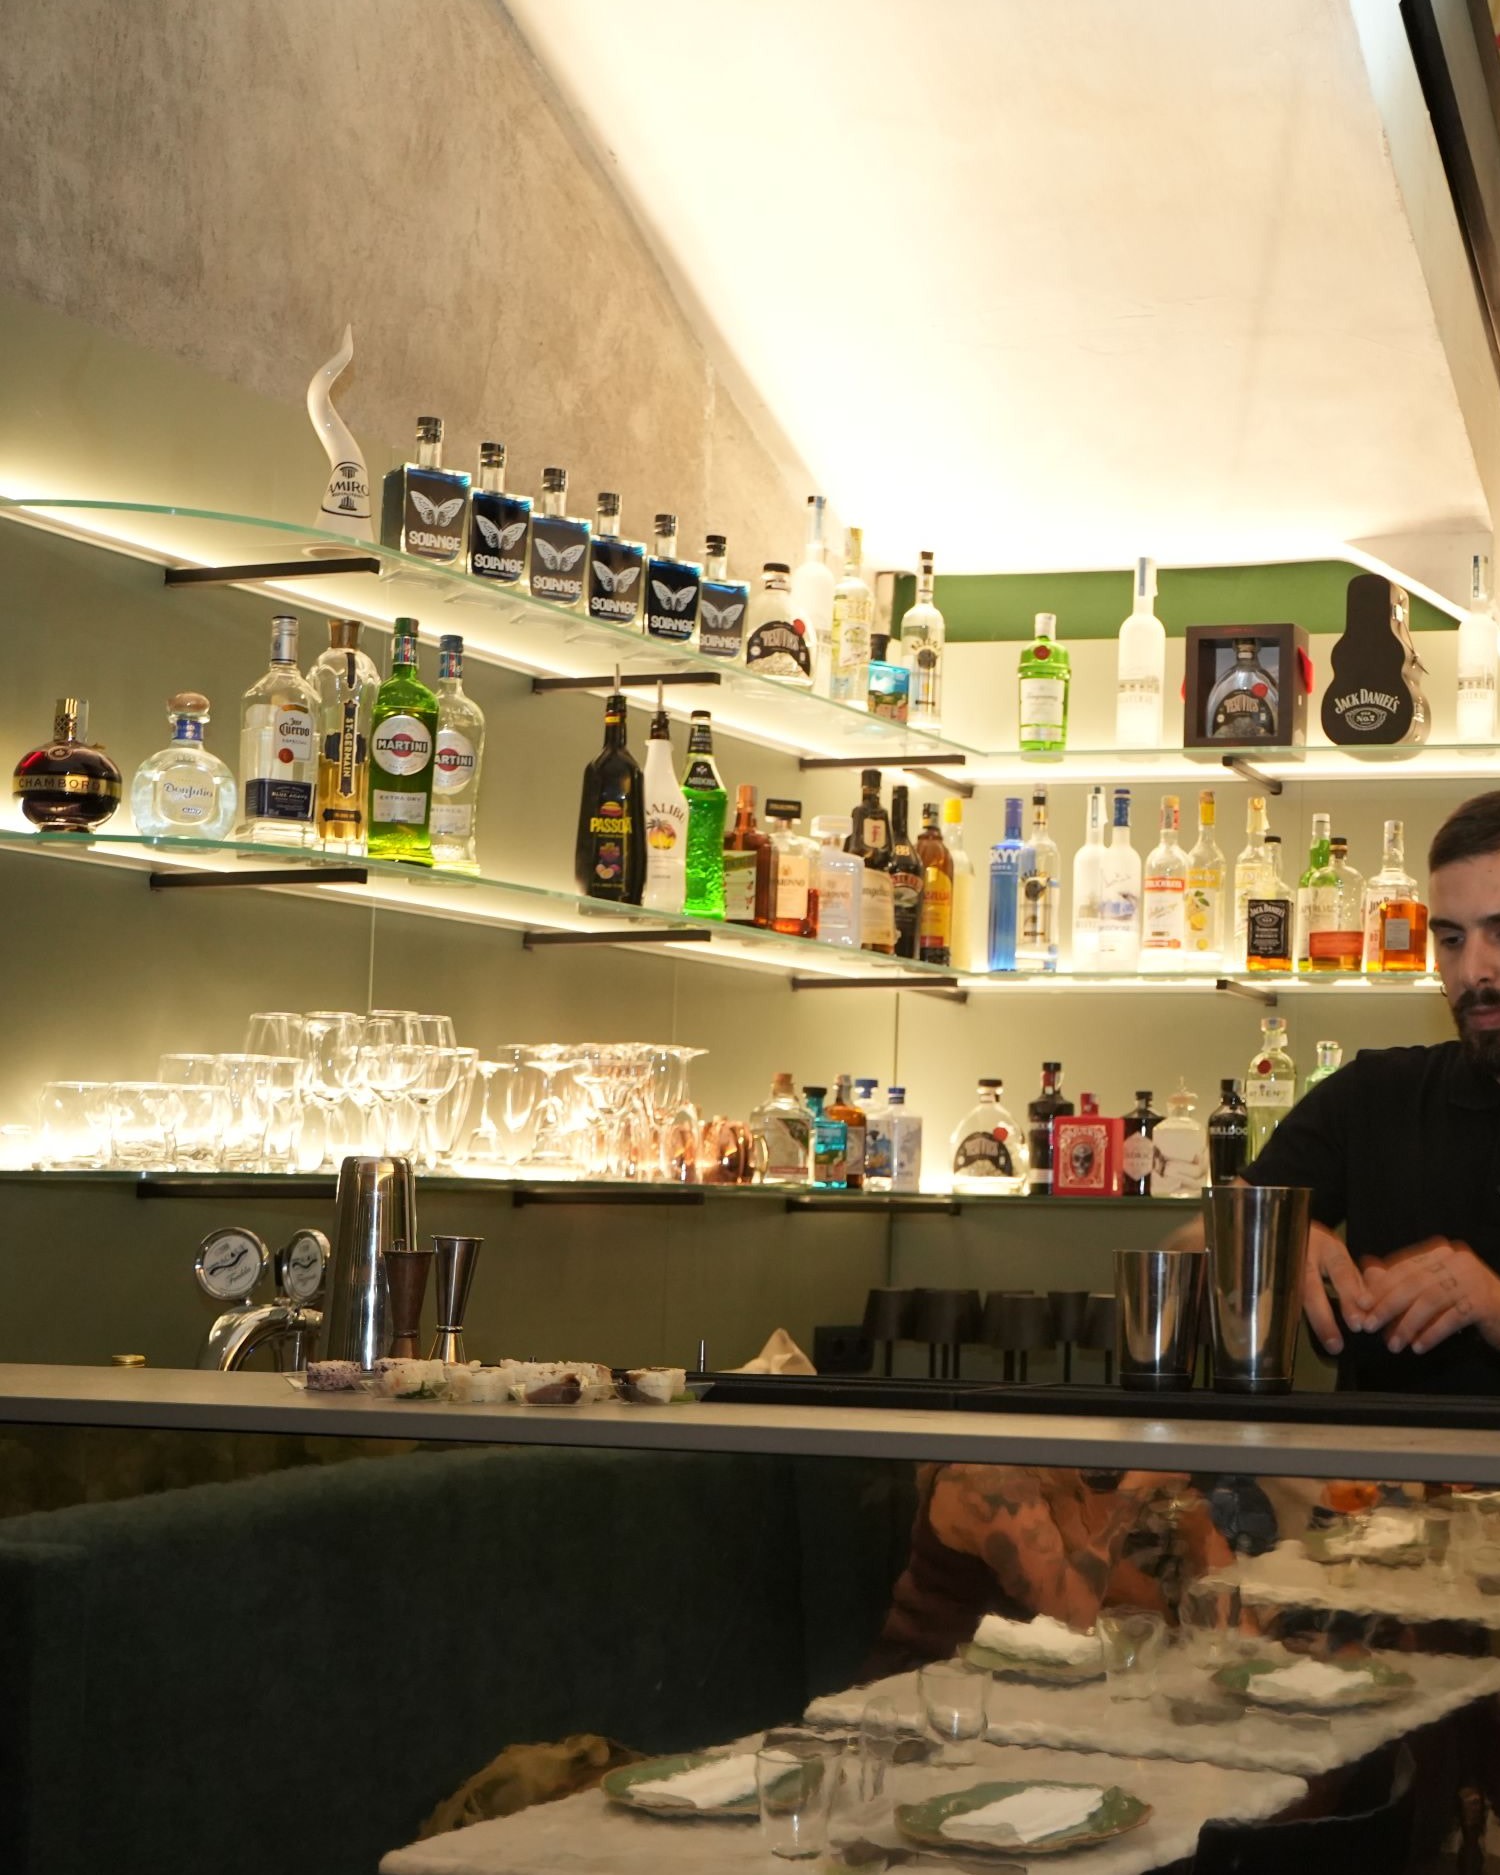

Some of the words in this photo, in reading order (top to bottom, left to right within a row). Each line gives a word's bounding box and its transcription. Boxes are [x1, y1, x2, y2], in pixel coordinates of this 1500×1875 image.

[1334, 692, 1360, 715] JACK
[1360, 688, 1401, 714] DANIEL'S
[279, 722, 310, 737] Cuervo
[377, 738, 428, 754] MARTINI
[434, 754, 473, 767] ARTINI
[18, 777, 100, 790] CHAMBORD
[646, 803, 685, 825] ALIBU
